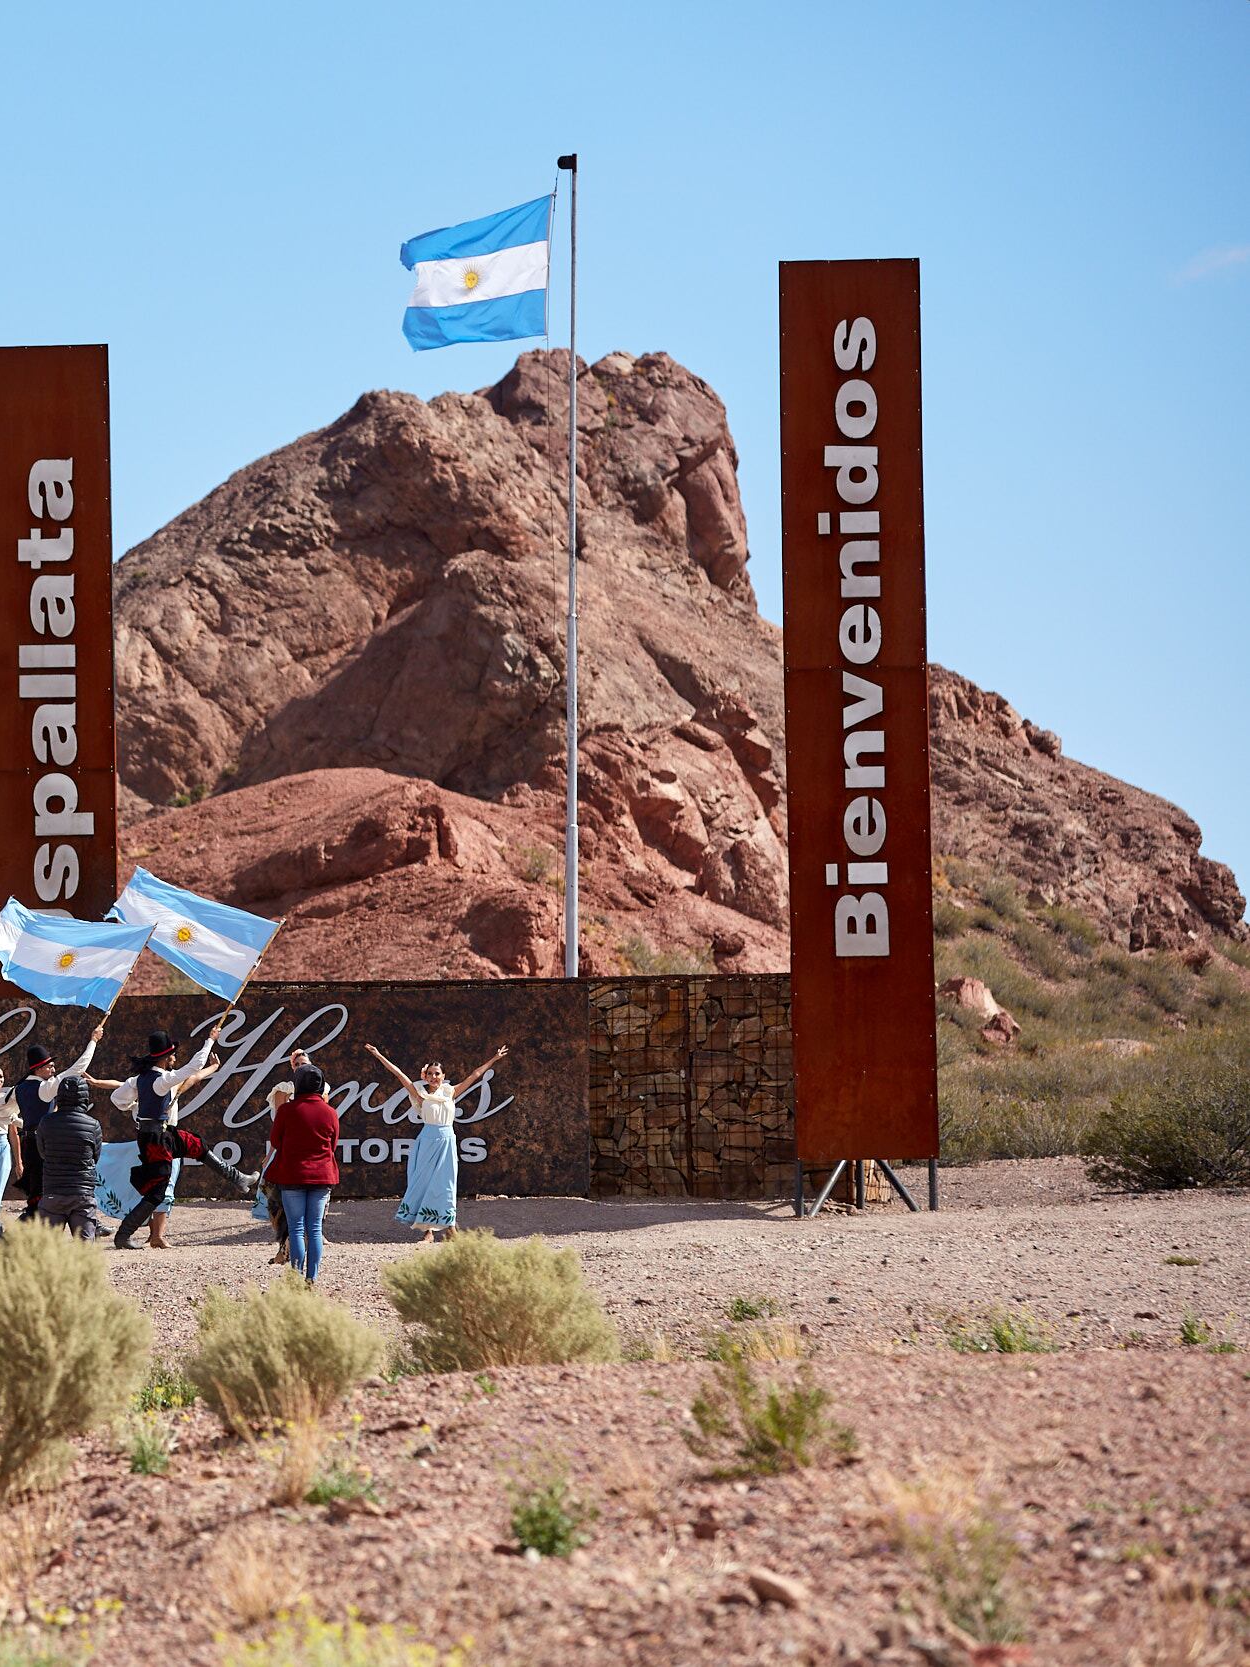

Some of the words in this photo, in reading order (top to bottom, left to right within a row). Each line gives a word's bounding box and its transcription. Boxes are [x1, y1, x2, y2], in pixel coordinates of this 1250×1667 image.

[17, 456, 94, 919] spallata
[818, 315, 890, 957] Bienvenidos
[178, 1003, 515, 1129] Hras
